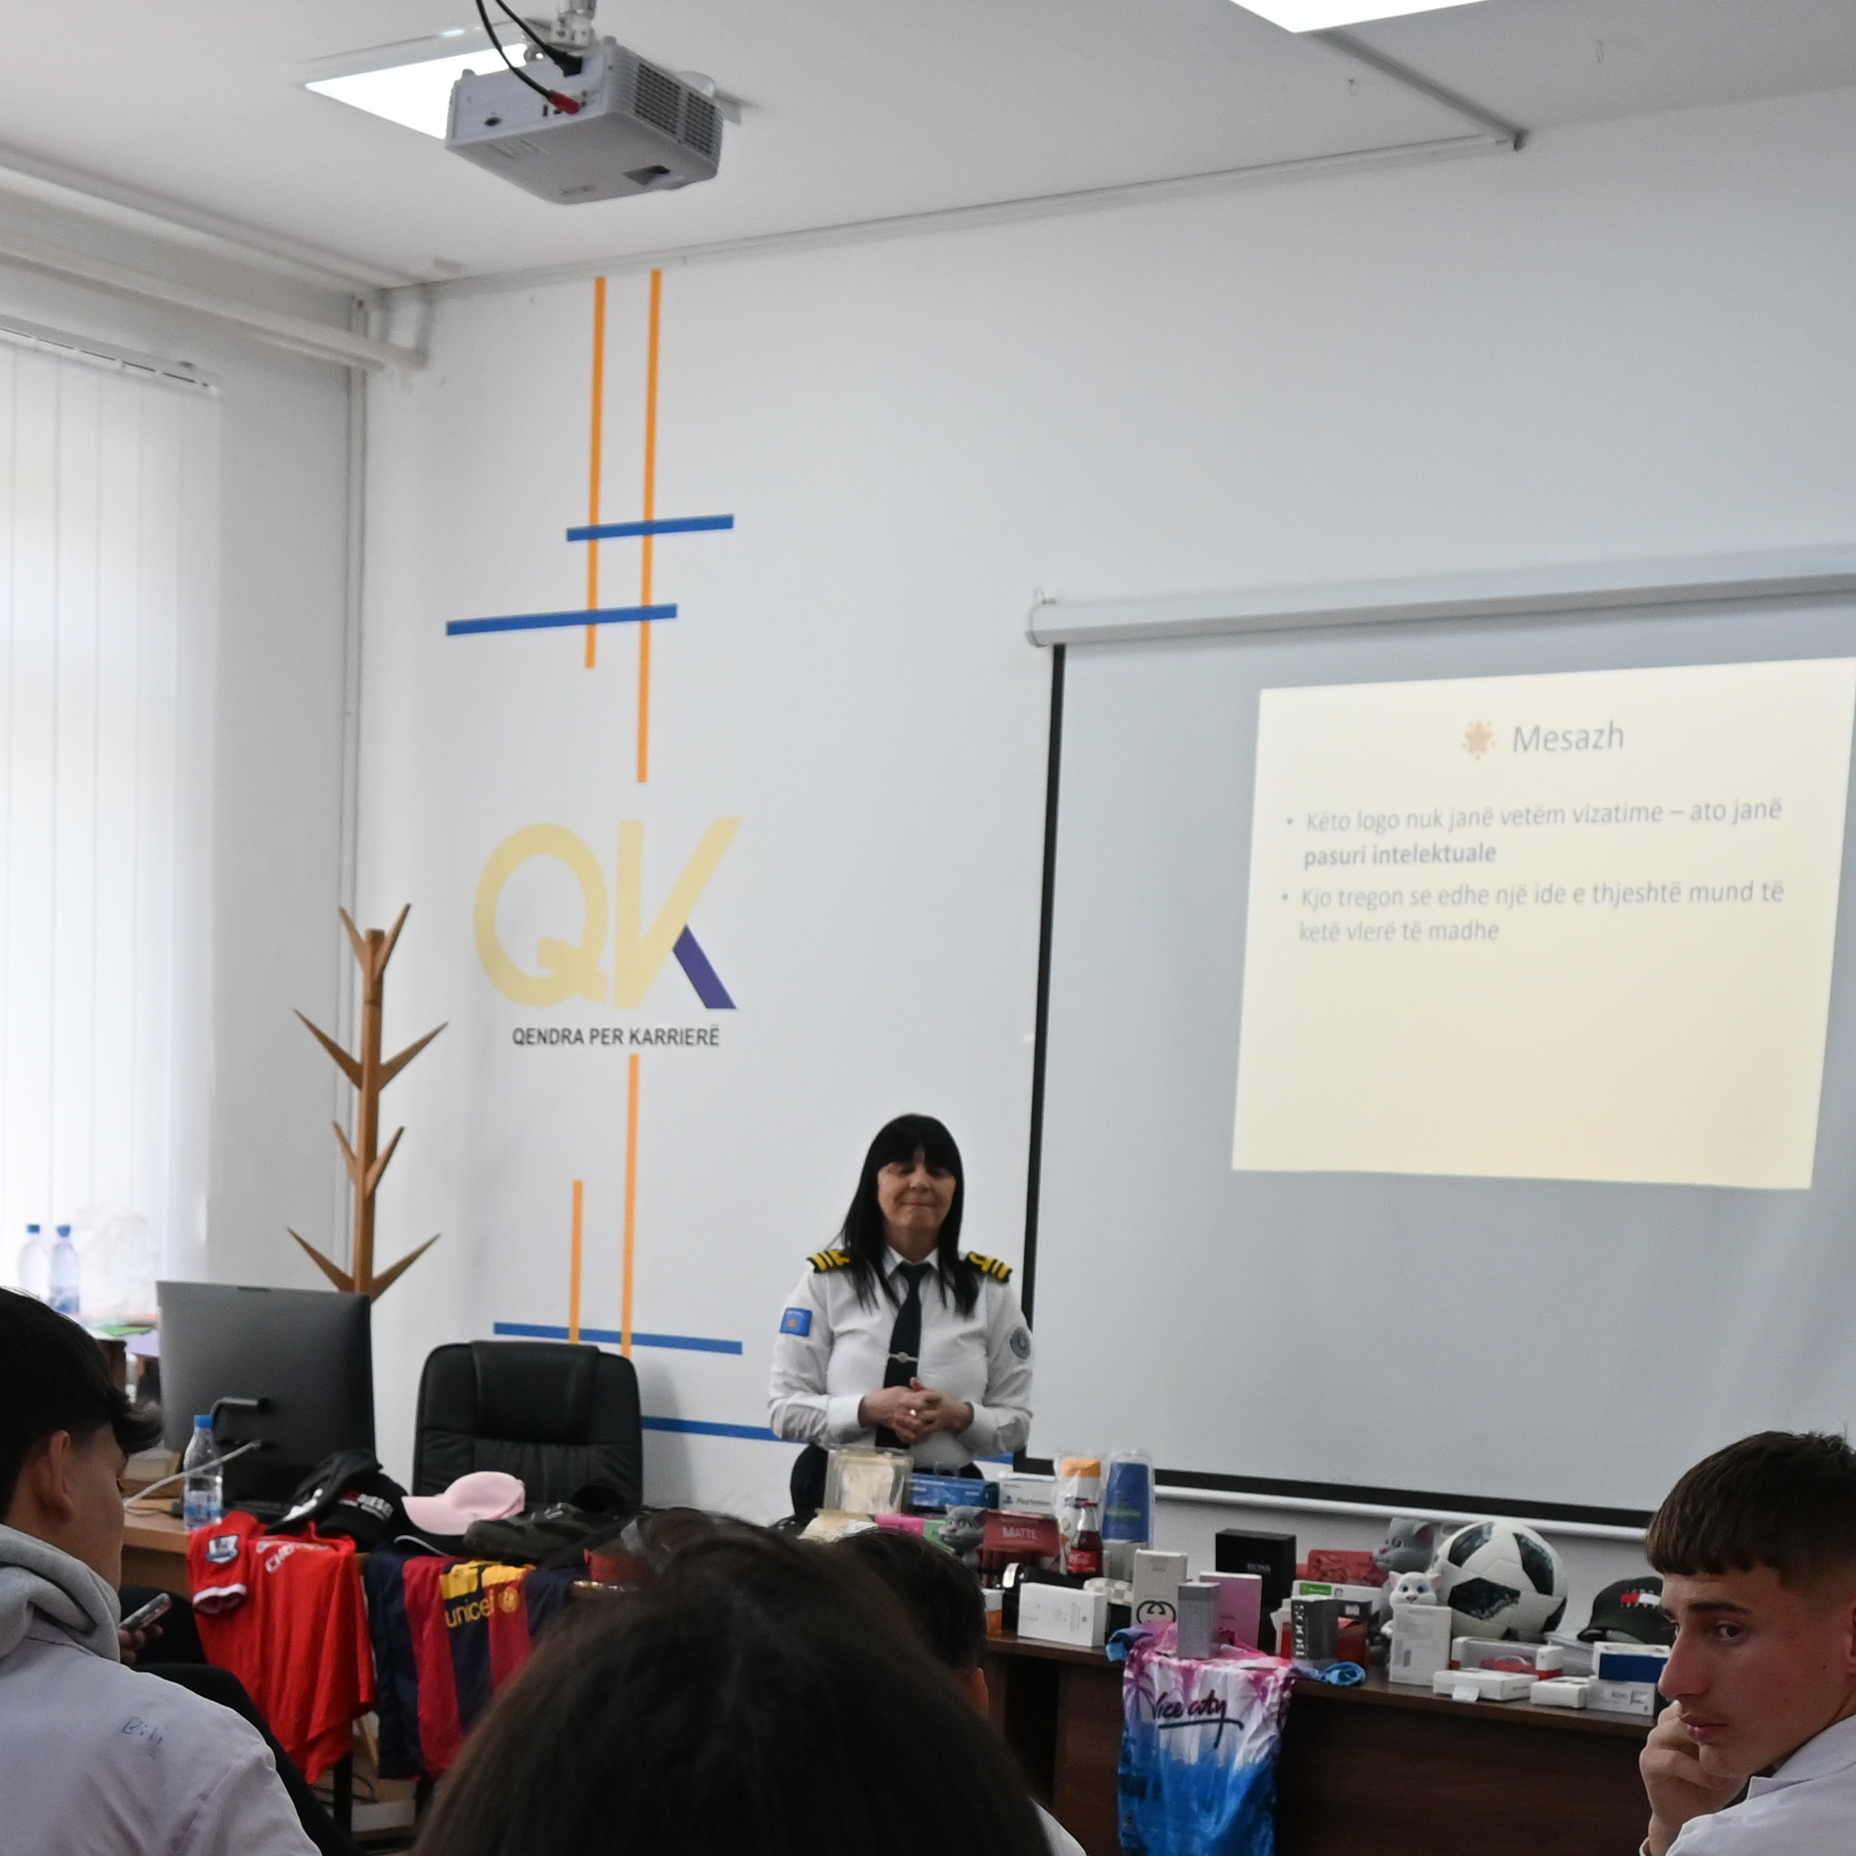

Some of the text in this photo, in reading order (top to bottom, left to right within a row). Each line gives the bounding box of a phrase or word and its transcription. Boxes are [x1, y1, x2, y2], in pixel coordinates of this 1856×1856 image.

[1513, 720, 1625, 753] Mesazh
[1306, 808, 1351, 832] Këto
[1357, 810, 1400, 835] logo
[1406, 807, 1444, 830] nuk
[1448, 806, 1494, 833] janë
[1500, 803, 1566, 827] vetëm
[1572, 801, 1665, 825] vizatime
[1689, 802, 1727, 822] ato
[1732, 797, 1783, 825] janë
[1303, 841, 1498, 871] pasuri intelektuale
[1301, 879, 1785, 912] Kjo tregon se edhe një ide e thjeshtë mund të
[474, 816, 743, 1010] QK
[1299, 920, 1500, 943] ketë vlerë të madhe
[512, 1022, 721, 1047] QENDRA PER KARRIERË
[1002, 1526, 1040, 1541] MATTE
